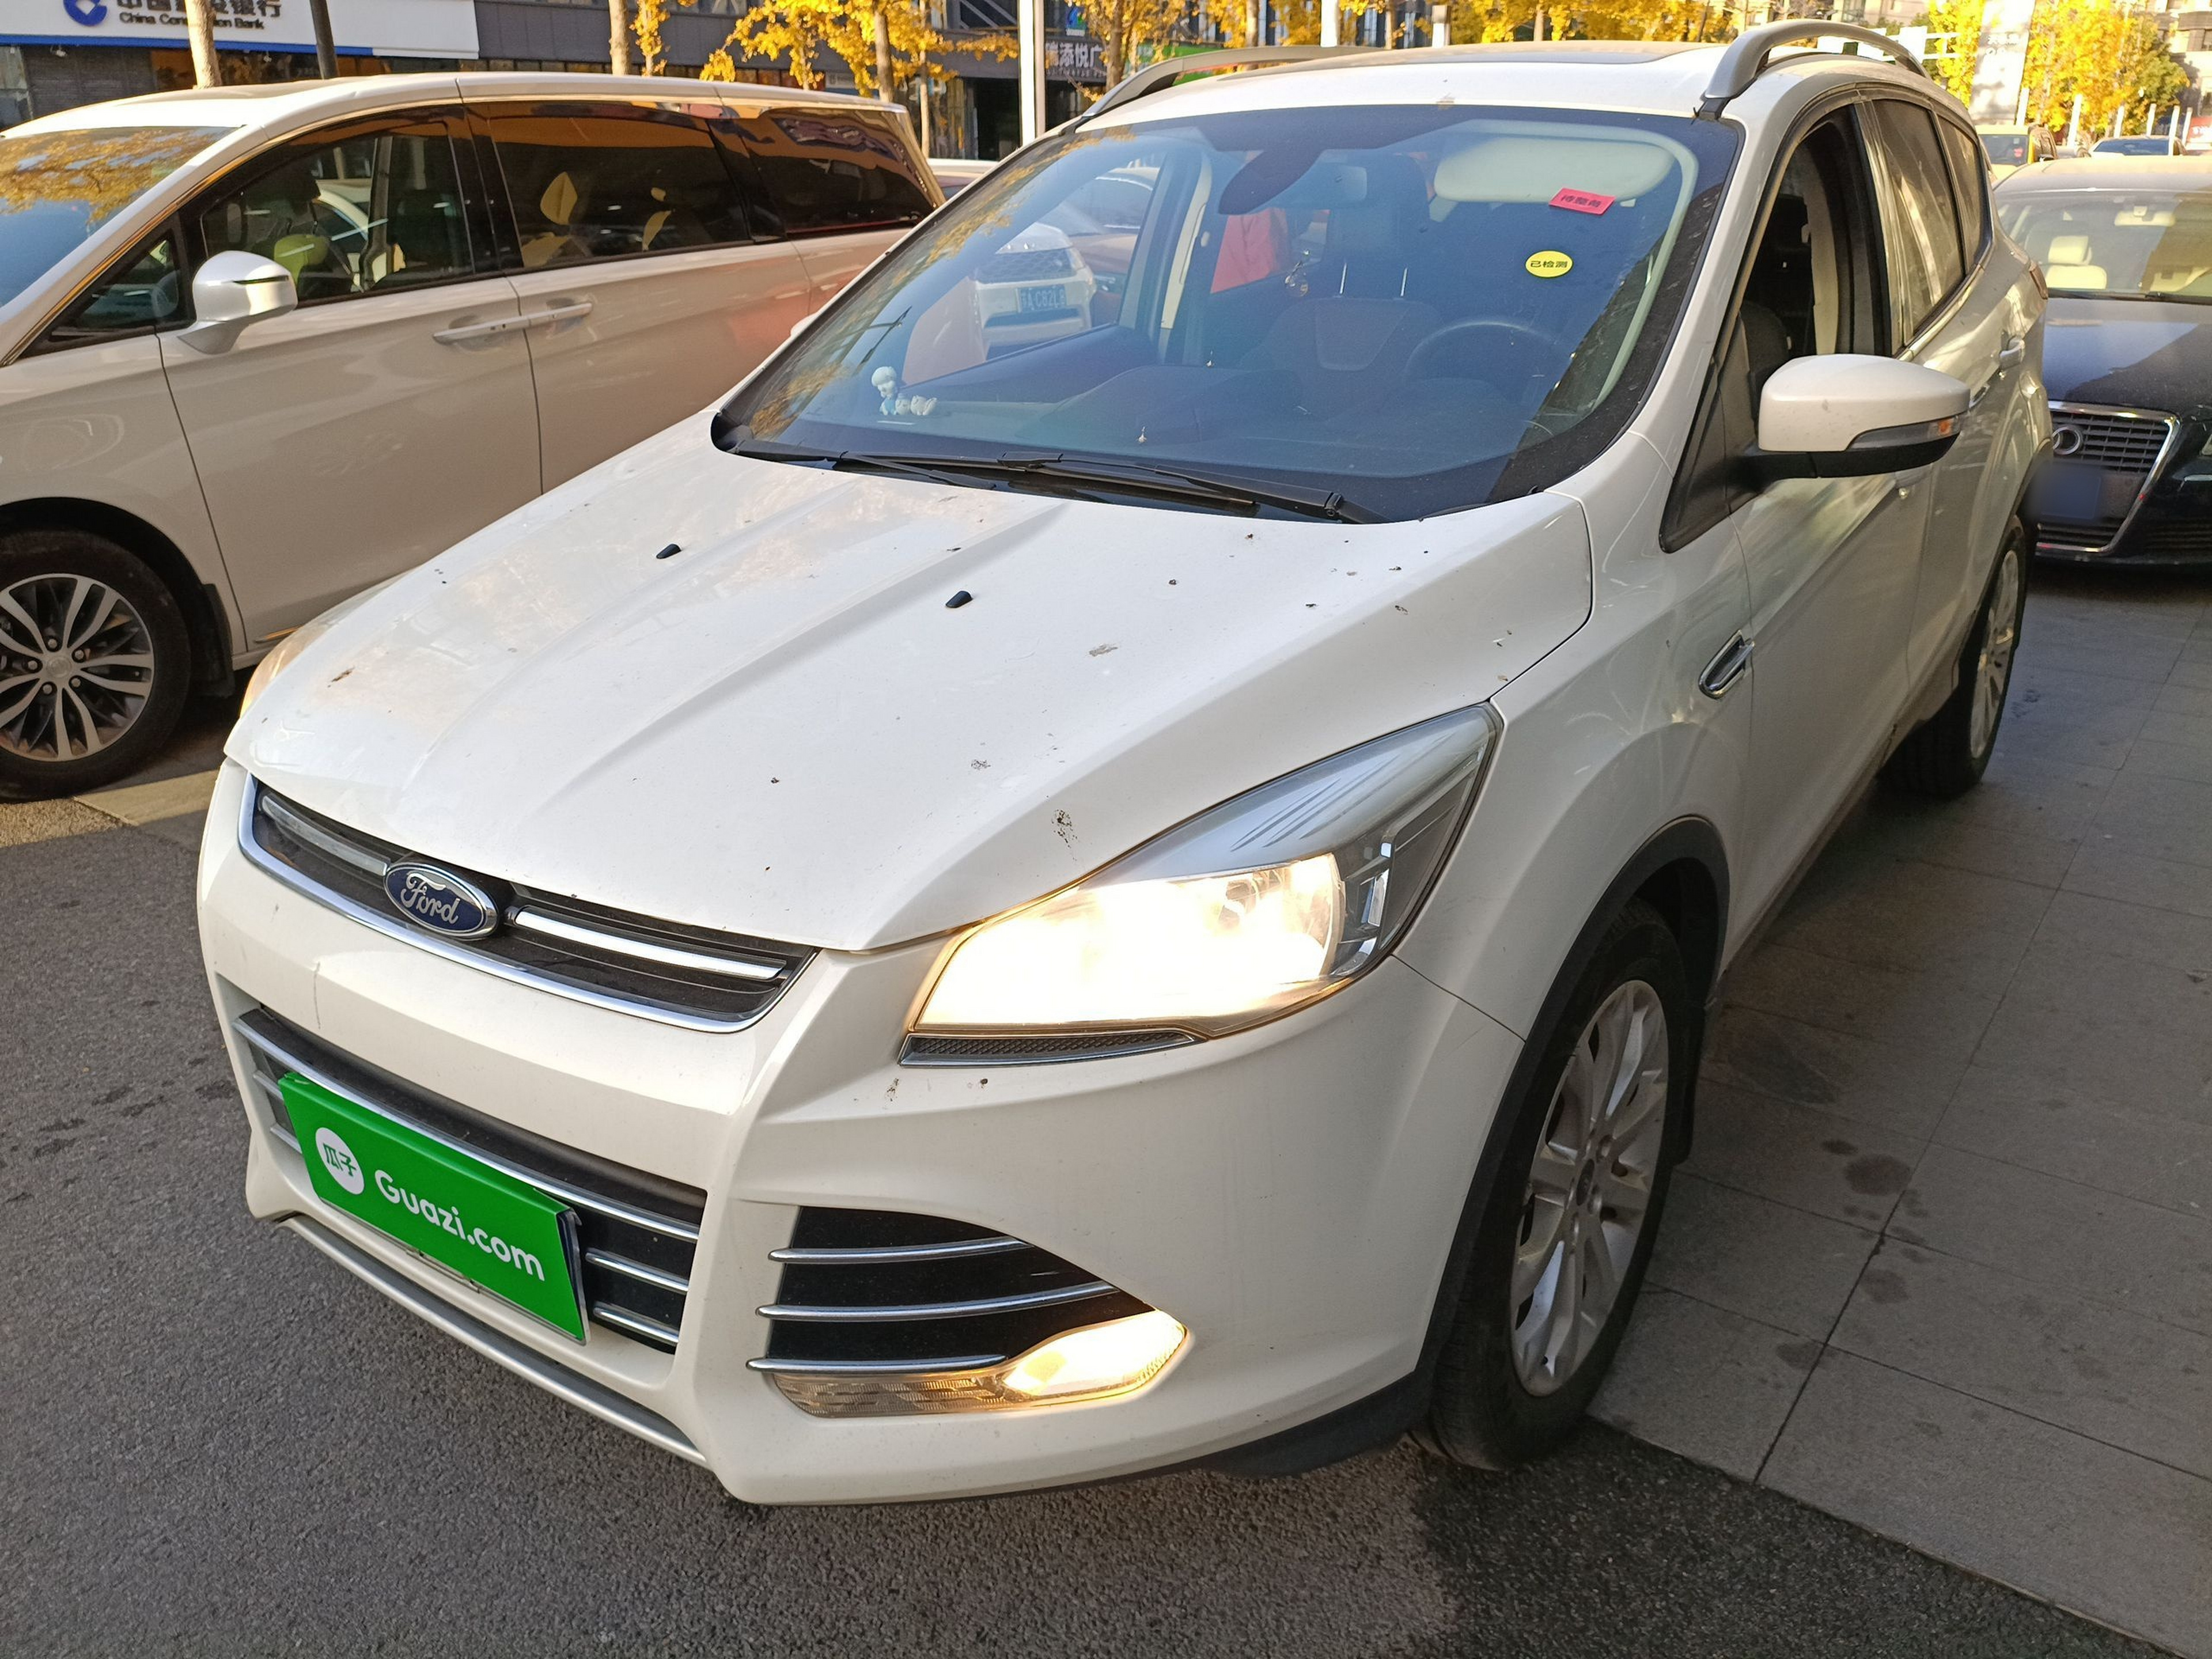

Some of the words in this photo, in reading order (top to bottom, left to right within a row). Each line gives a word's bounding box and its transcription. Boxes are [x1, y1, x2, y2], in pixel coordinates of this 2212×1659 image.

[119, 12, 156, 24] China
[234, 18, 264, 29] Bank
[1530, 260, 1568, 268] 已检测
[400, 871, 460, 925] Ford
[323, 1143, 357, 1177] 瓜子
[374, 1169, 545, 1281] Guazi.com
